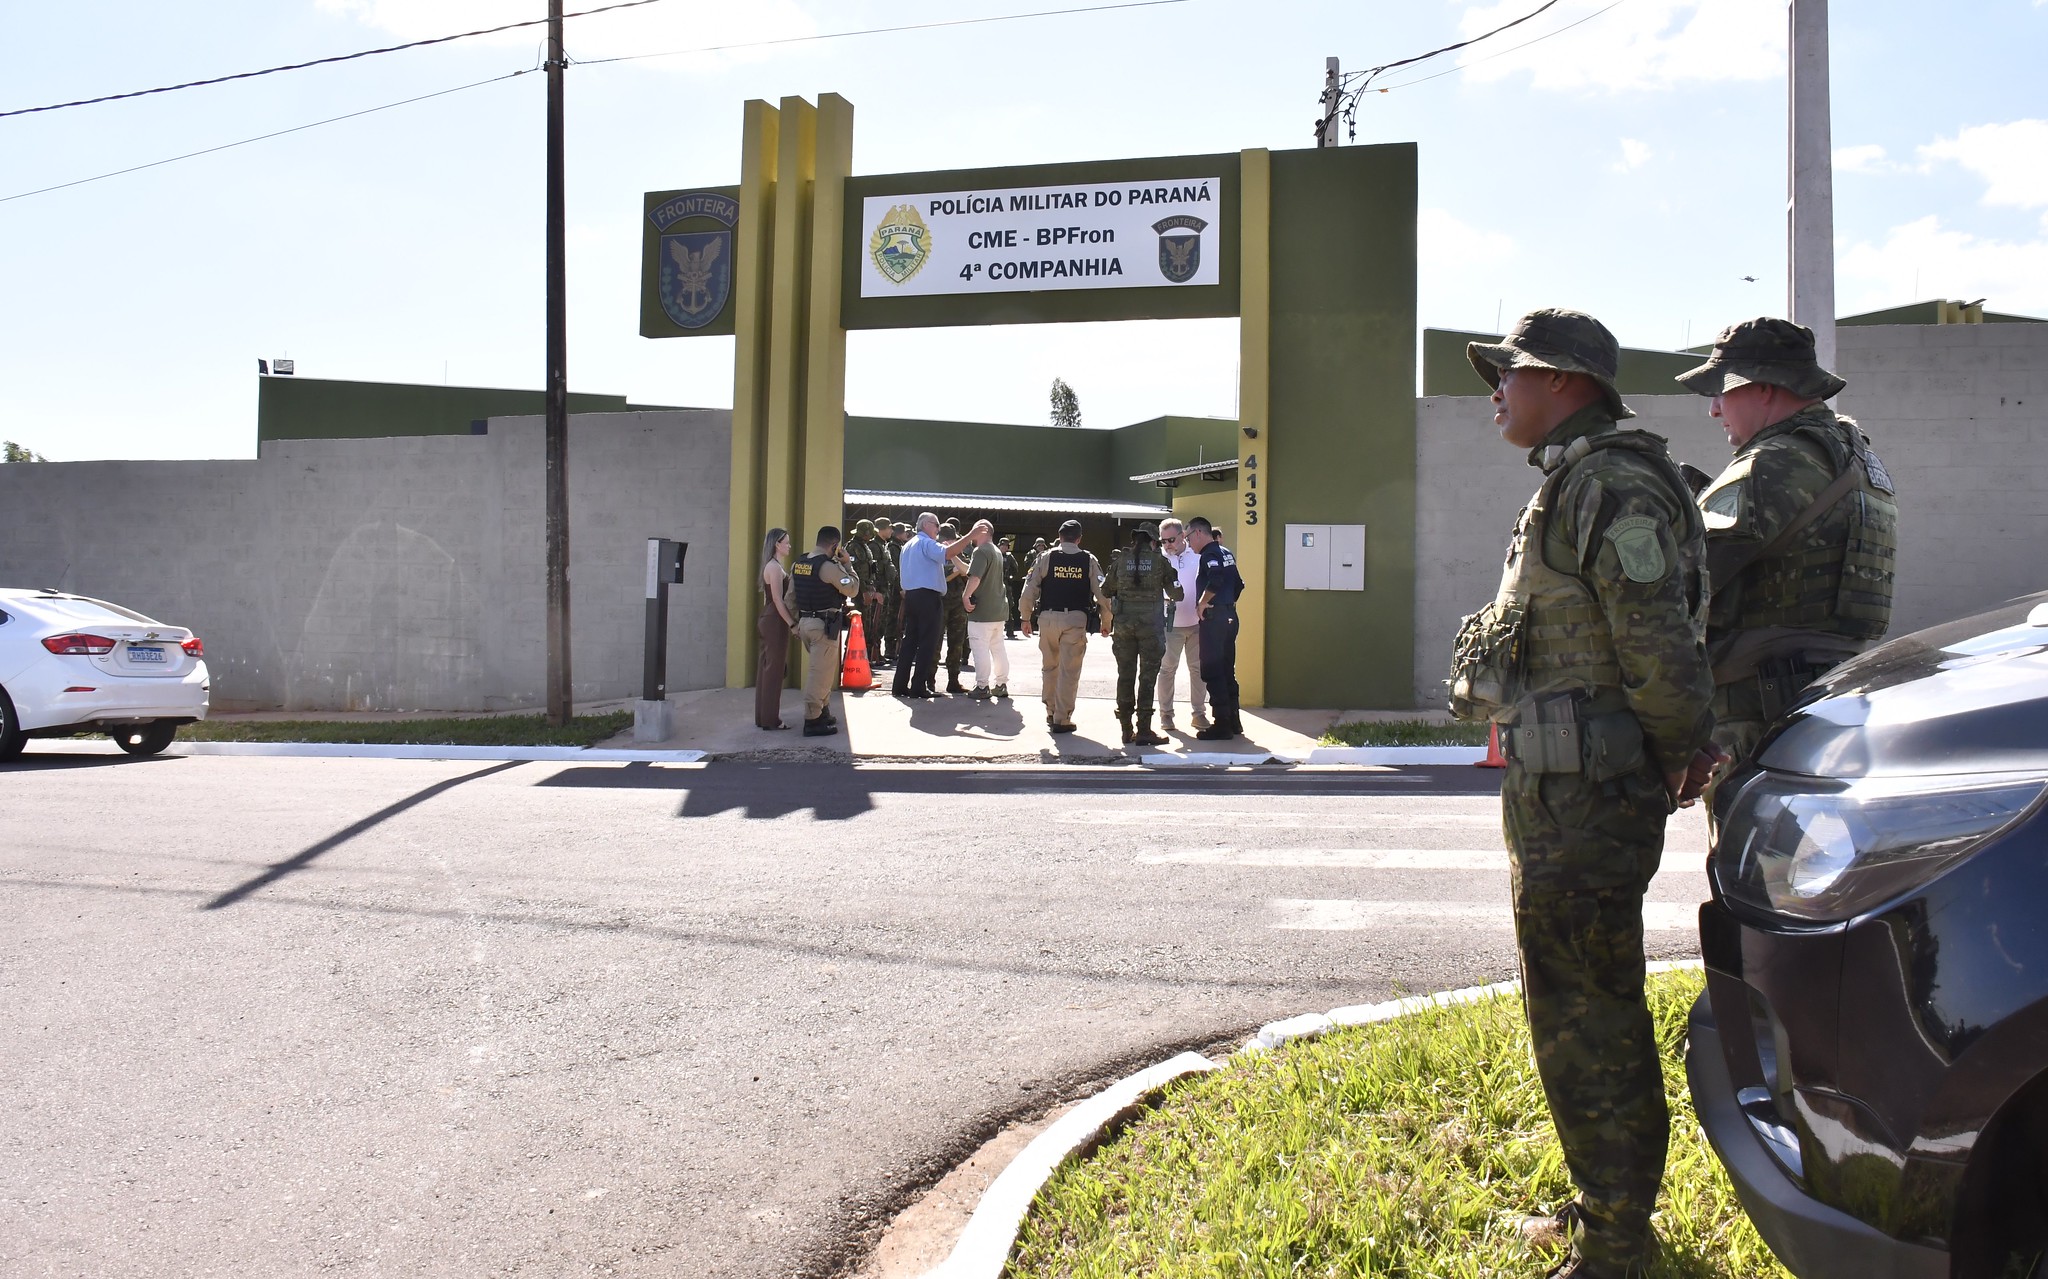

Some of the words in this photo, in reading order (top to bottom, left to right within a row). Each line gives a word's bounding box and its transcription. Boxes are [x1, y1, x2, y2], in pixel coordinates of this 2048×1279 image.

[656, 198, 735, 224] FRONTEIRA
[930, 194, 1004, 216] POLÍCIA
[1010, 192, 1088, 212] MILITAR
[1094, 190, 1122, 207] DO
[1128, 181, 1211, 206] PARANÁ
[1157, 217, 1201, 231] FRONTEIRA
[968, 229, 1017, 250] CME
[1036, 226, 1115, 246] BPFron
[959, 263, 982, 282] 4ª
[988, 257, 1123, 280] COMPANHIA
[1244, 454, 1258, 526] 4133
[1609, 518, 1654, 537] FRONTEIRA
